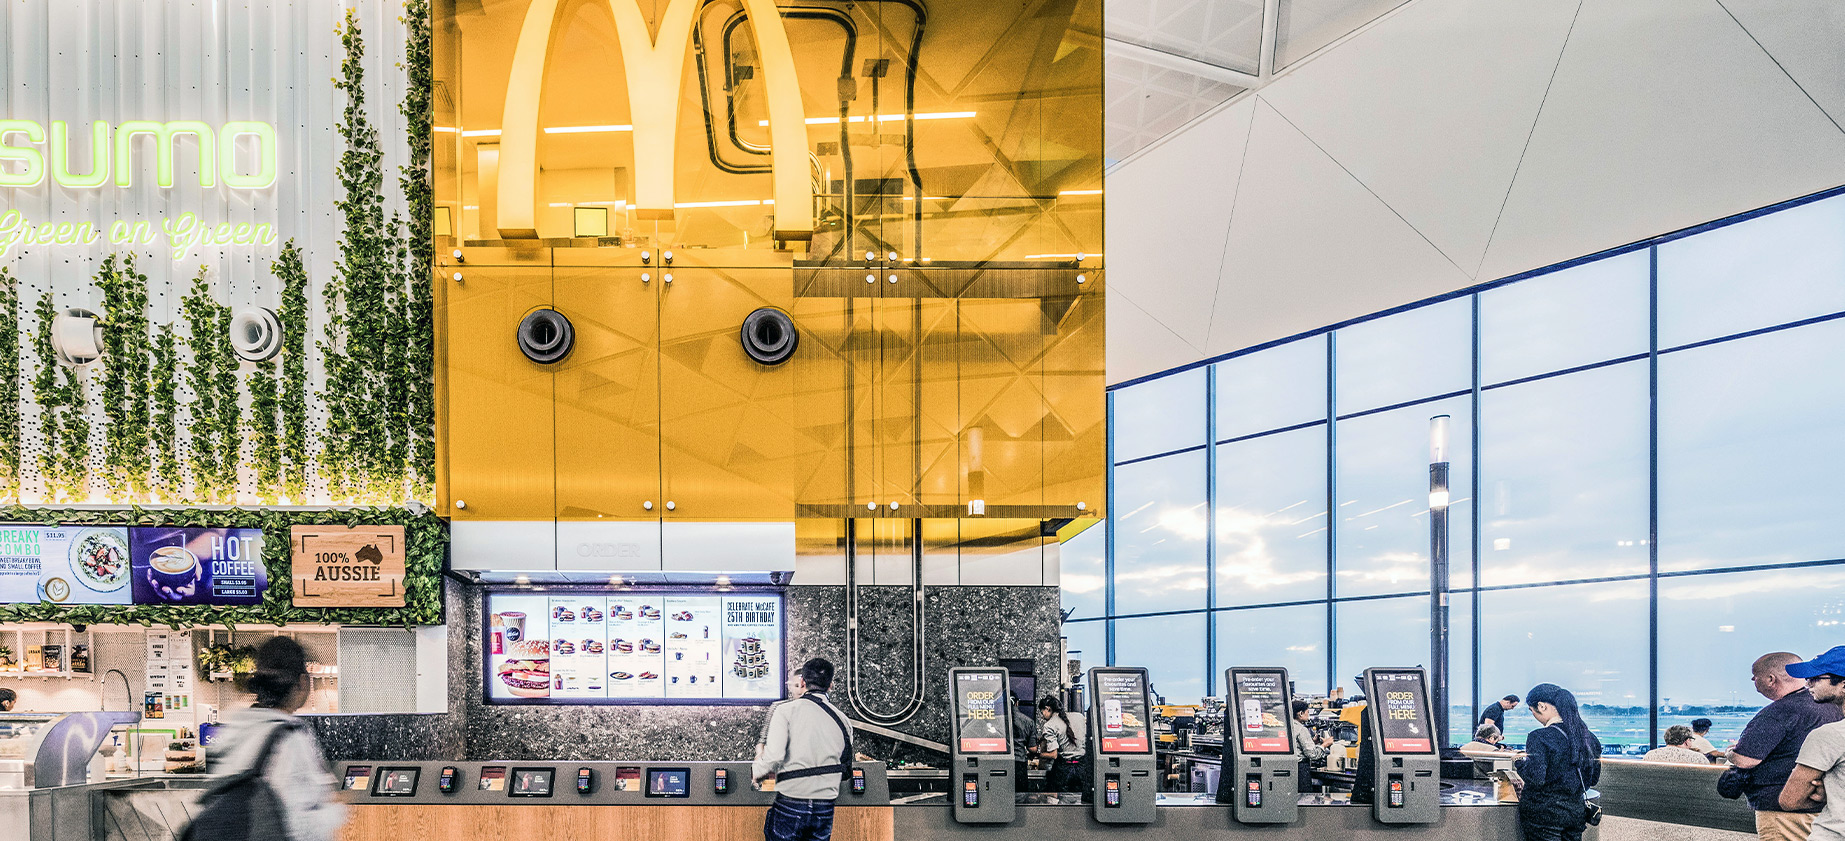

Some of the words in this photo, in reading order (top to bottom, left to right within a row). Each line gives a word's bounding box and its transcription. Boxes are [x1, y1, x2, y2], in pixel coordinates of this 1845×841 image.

[0, 208, 99, 258] Green
[108, 219, 155, 246] on
[161, 211, 277, 261] Green
[211, 536, 253, 560] HOT
[577, 542, 641, 558] ORDER
[314, 552, 350, 564] 100%
[212, 561, 255, 575] COFFEE
[314, 565, 380, 581] AUSSIE
[727, 602, 753, 611] CELEBRATE
[727, 612, 743, 622] 25TH
[745, 612, 775, 622] BIRTHDAY
[967, 692, 994, 700] ORDER
[1386, 692, 1414, 700] ORDER
[968, 710, 995, 719] HERE
[1389, 710, 1417, 719] HERE
